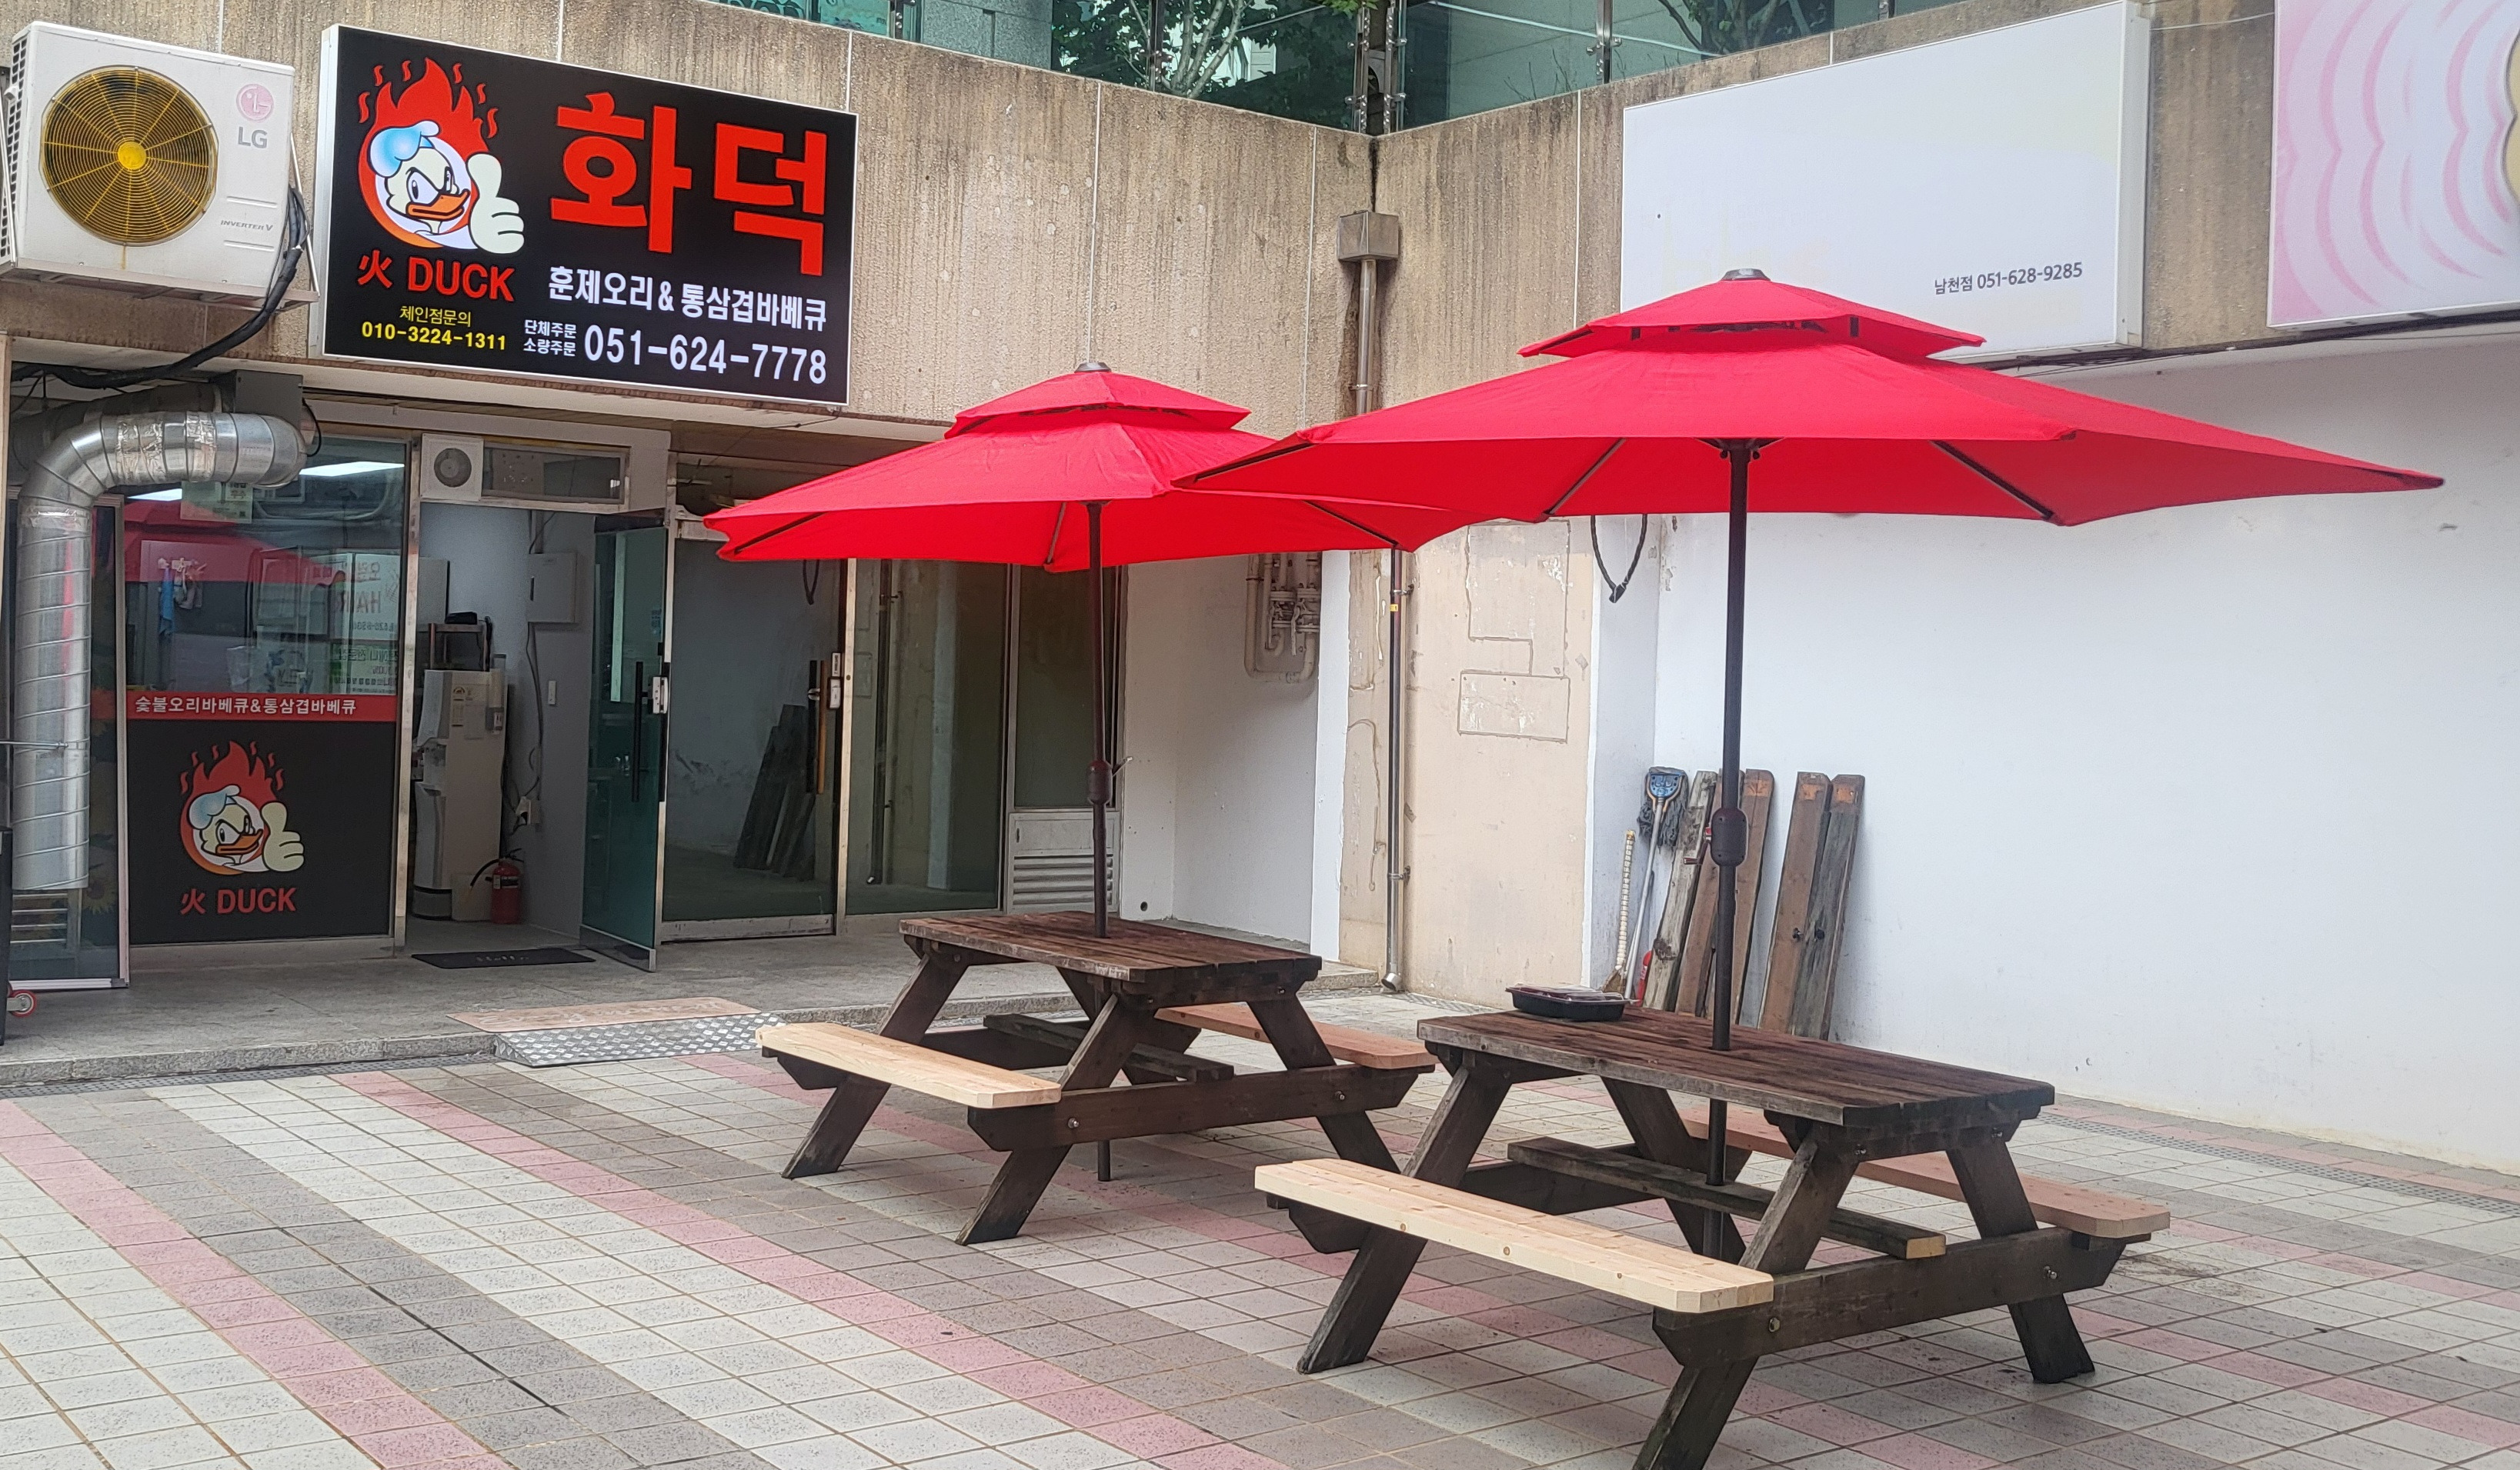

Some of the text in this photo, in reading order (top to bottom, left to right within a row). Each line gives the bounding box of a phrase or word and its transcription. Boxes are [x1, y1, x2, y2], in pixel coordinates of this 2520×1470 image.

[238, 126, 268, 149] LG
[549, 92, 827, 276] 화덕
[220, 219, 264, 230] INVERTER
[358, 249, 515, 302] 火 DUCK
[1934, 262, 2083, 295] 남천점 051-628-9285
[399, 305, 471, 327] 체인점문의
[525, 319, 576, 338] 단체주문
[362, 322, 506, 350] 010-3224-1311
[523, 338, 576, 356] 소량주문
[584, 324, 826, 384] 051-624-7778
[181, 888, 296, 915] 火 DUCK
